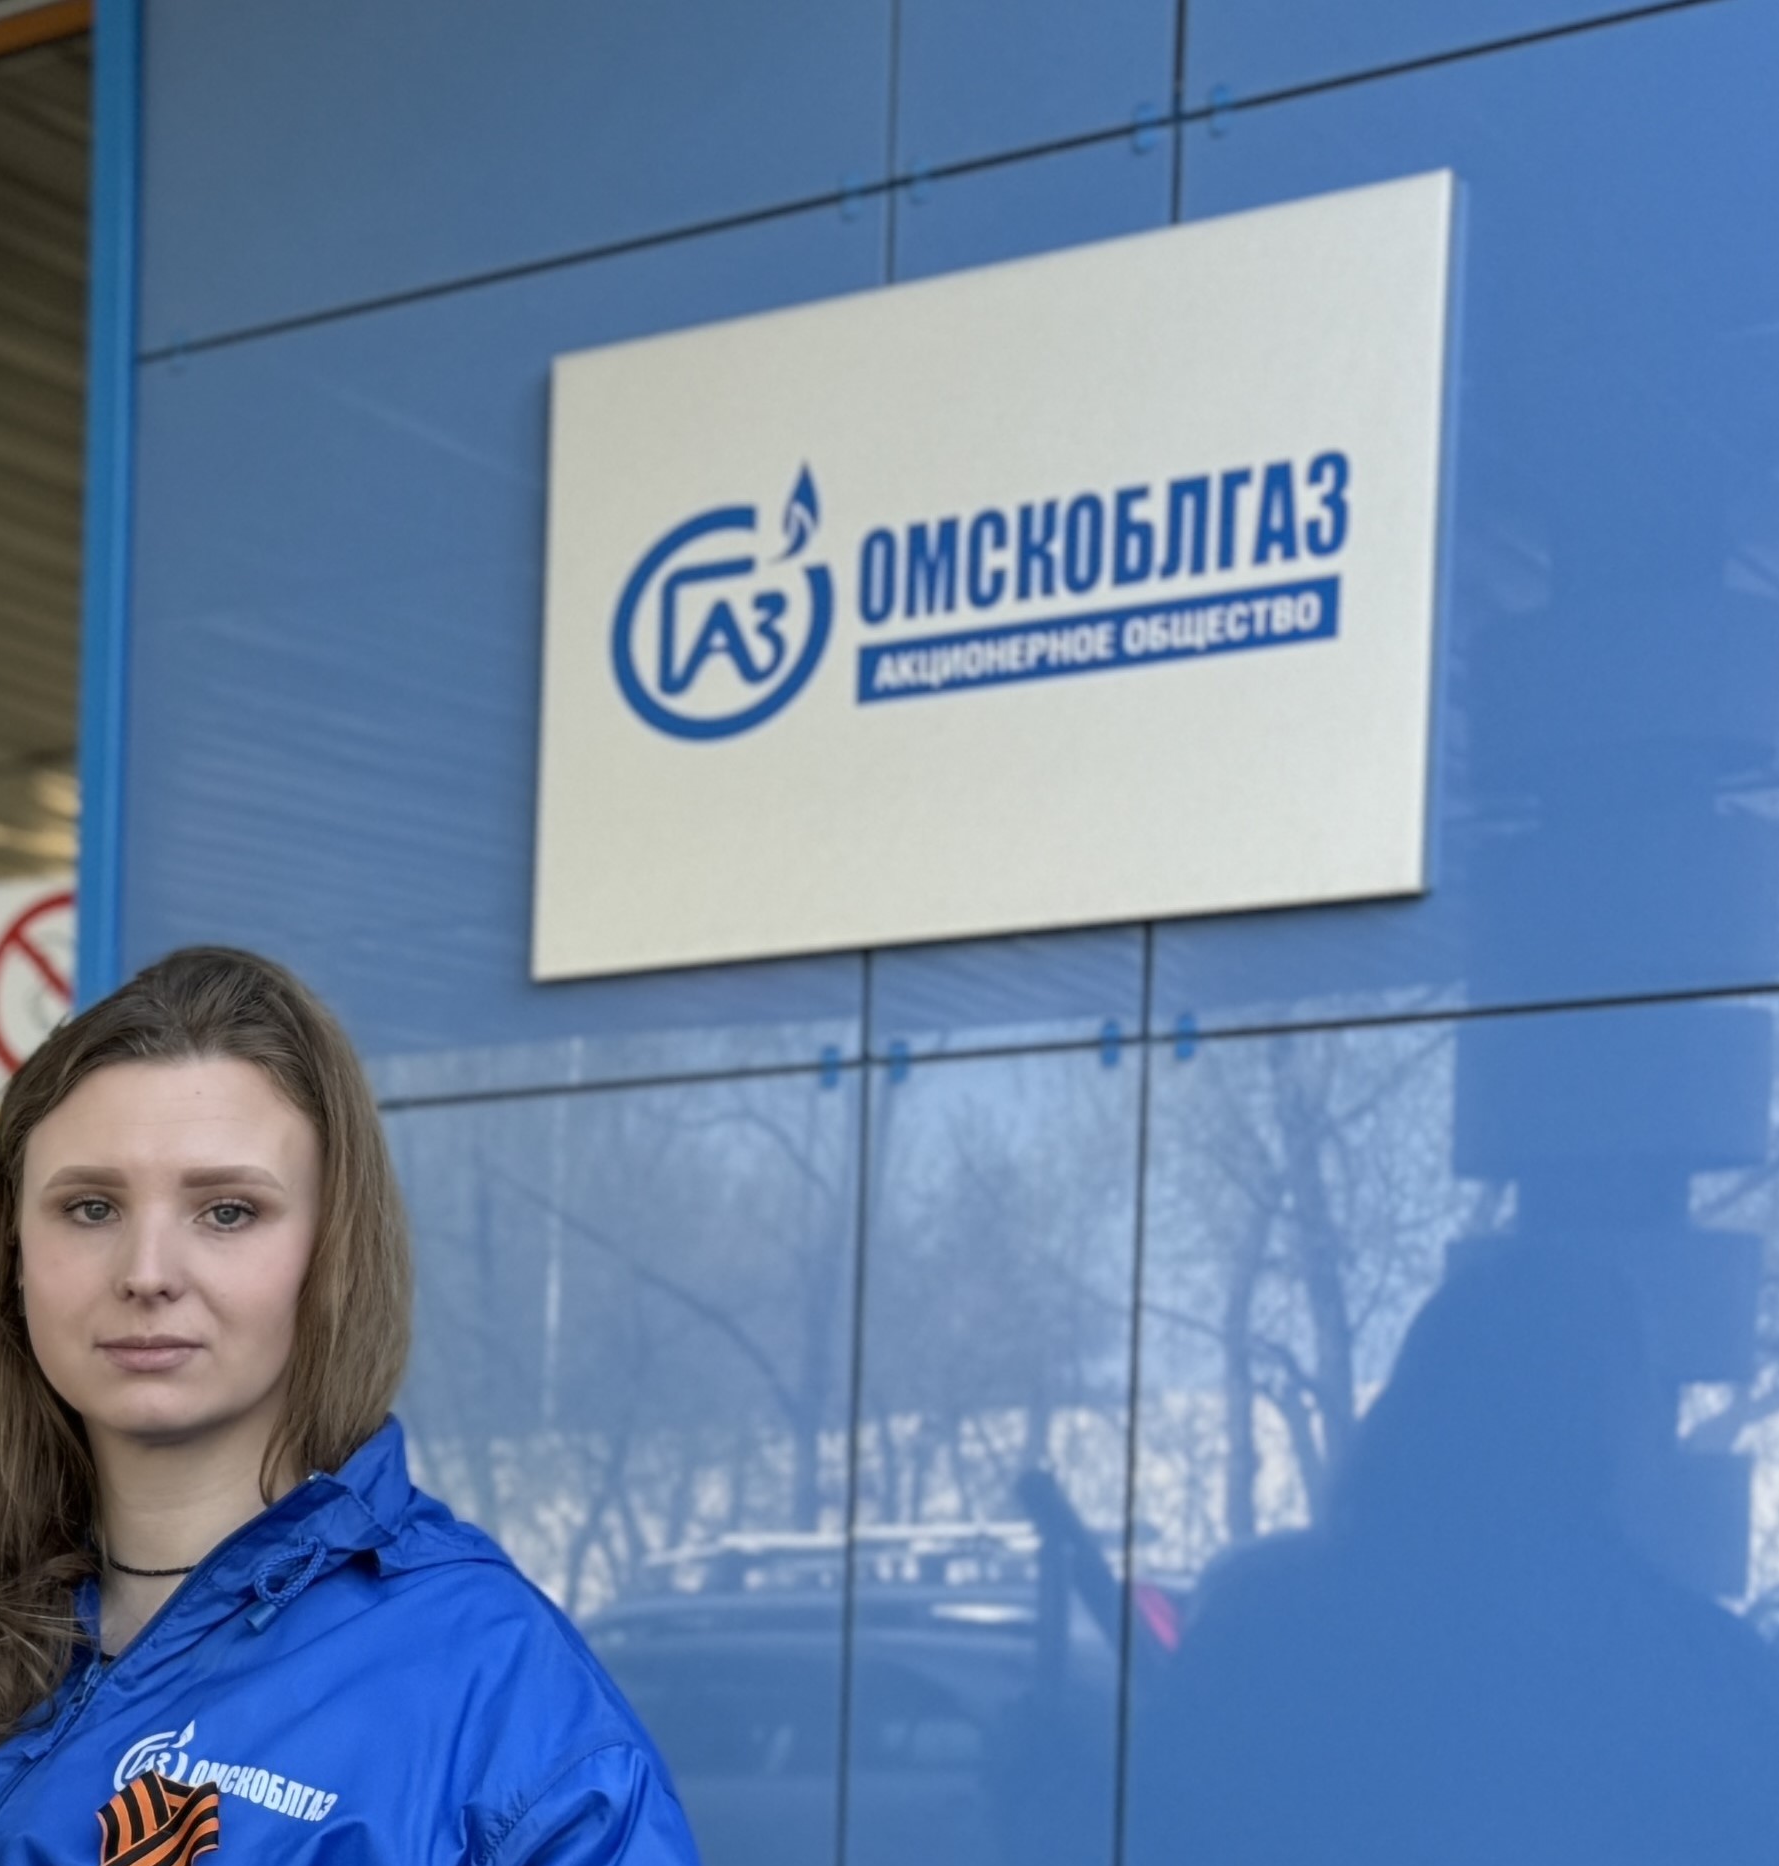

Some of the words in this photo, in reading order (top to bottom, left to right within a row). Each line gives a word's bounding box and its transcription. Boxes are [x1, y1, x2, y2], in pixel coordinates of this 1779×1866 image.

[857, 450, 1351, 627] ОМСКОБЛГАЗ
[872, 622, 1116, 691] АКЦИОНЕРНОЕ
[1123, 591, 1323, 655] ОБЩЕСТВО
[188, 1759, 339, 1822] ОМСКОБЛГАЗ
